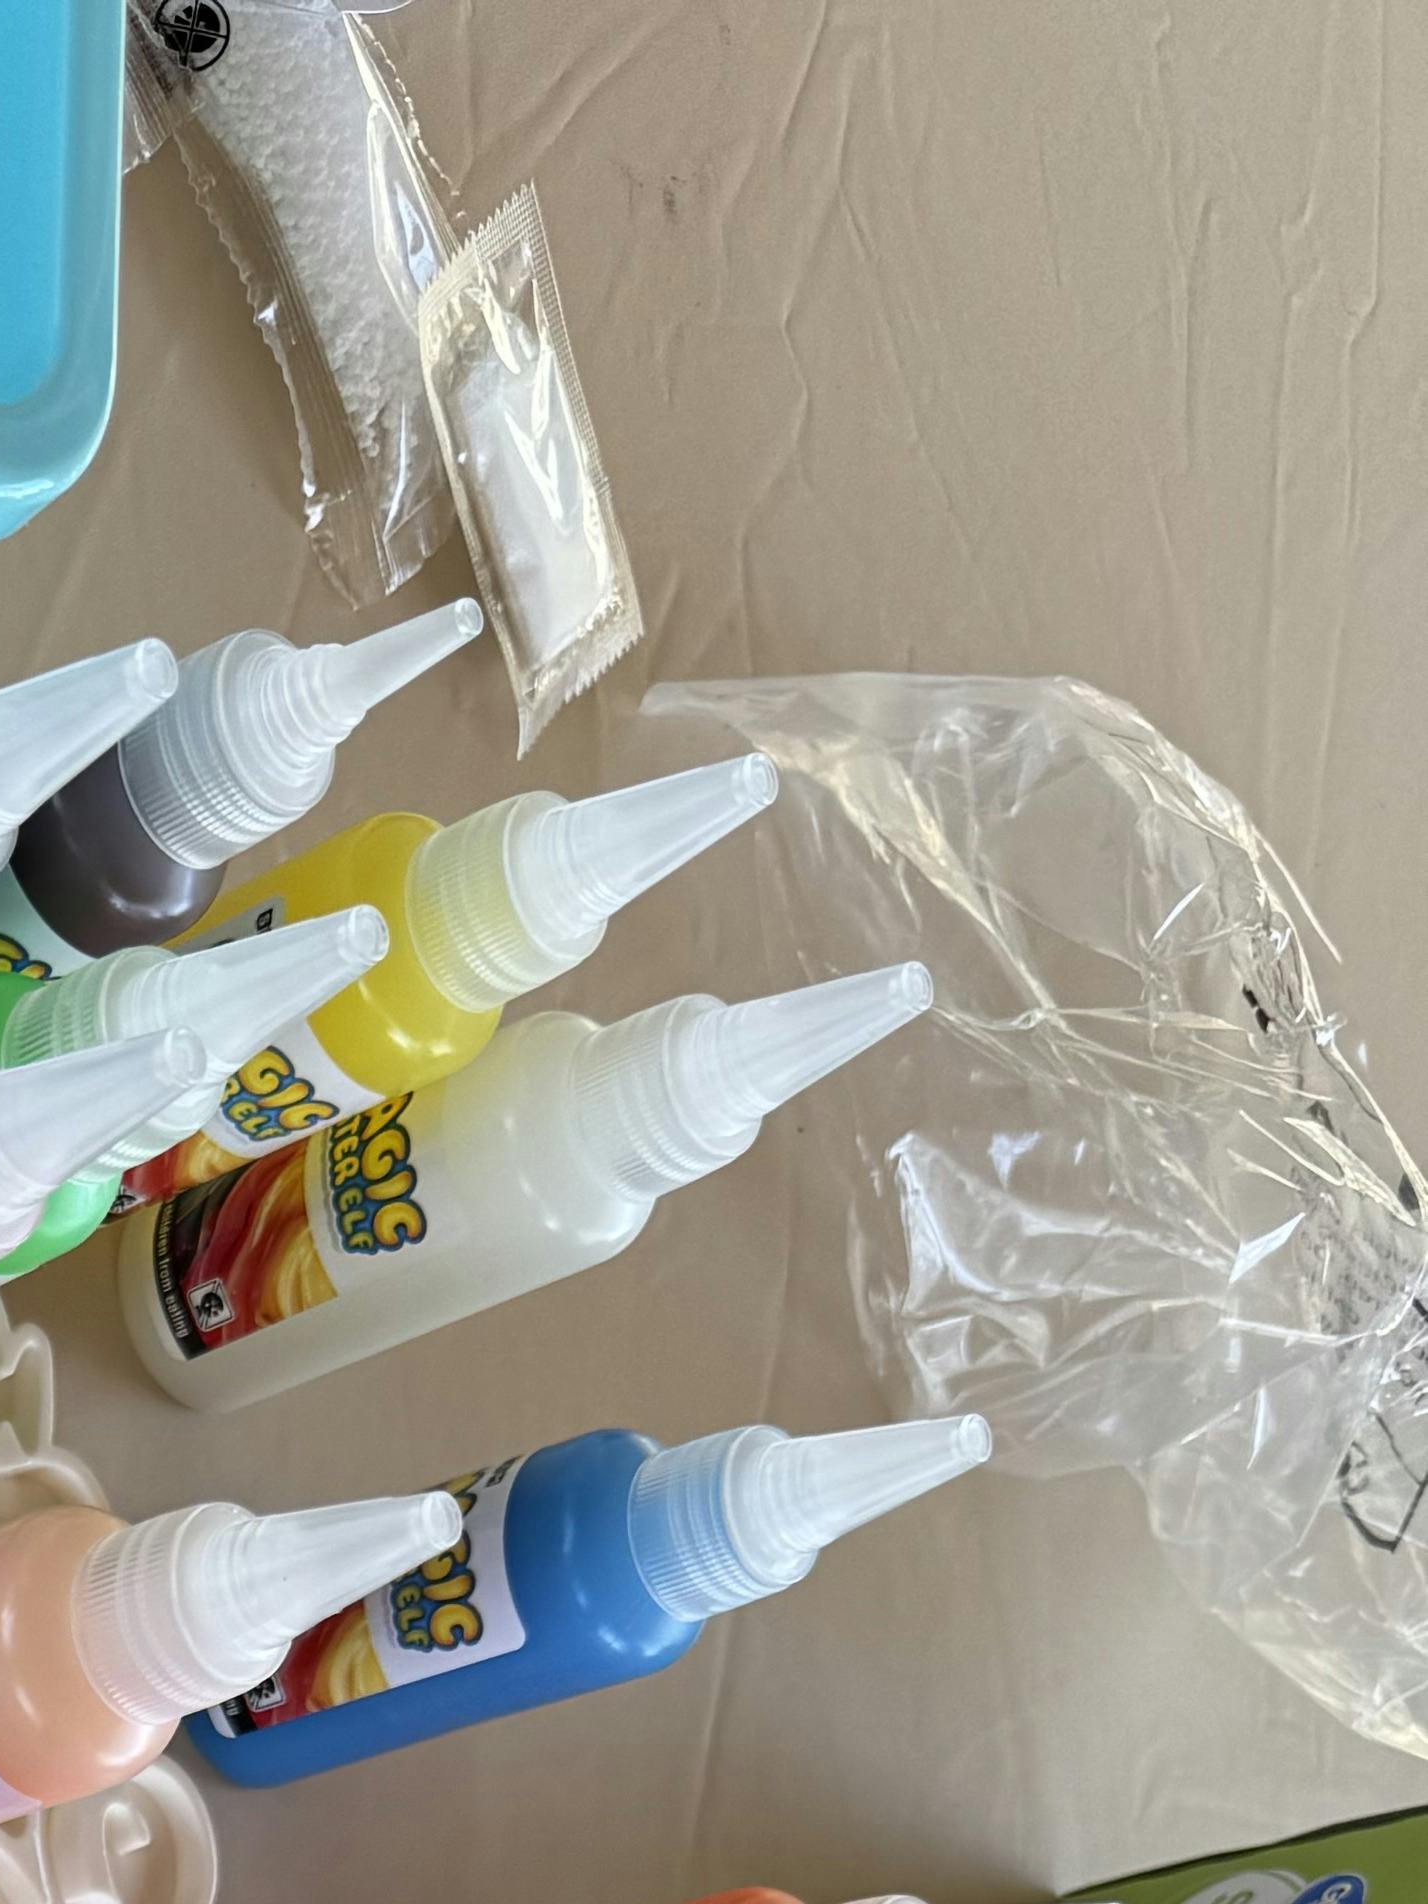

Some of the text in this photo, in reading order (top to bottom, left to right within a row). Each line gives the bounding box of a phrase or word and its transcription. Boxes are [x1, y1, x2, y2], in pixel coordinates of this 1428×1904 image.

[329, 1113, 365, 1186] TER
[360, 1092, 428, 1247] AGIC
[333, 1184, 377, 1256] ELF
[393, 1584, 435, 1653] ELF
